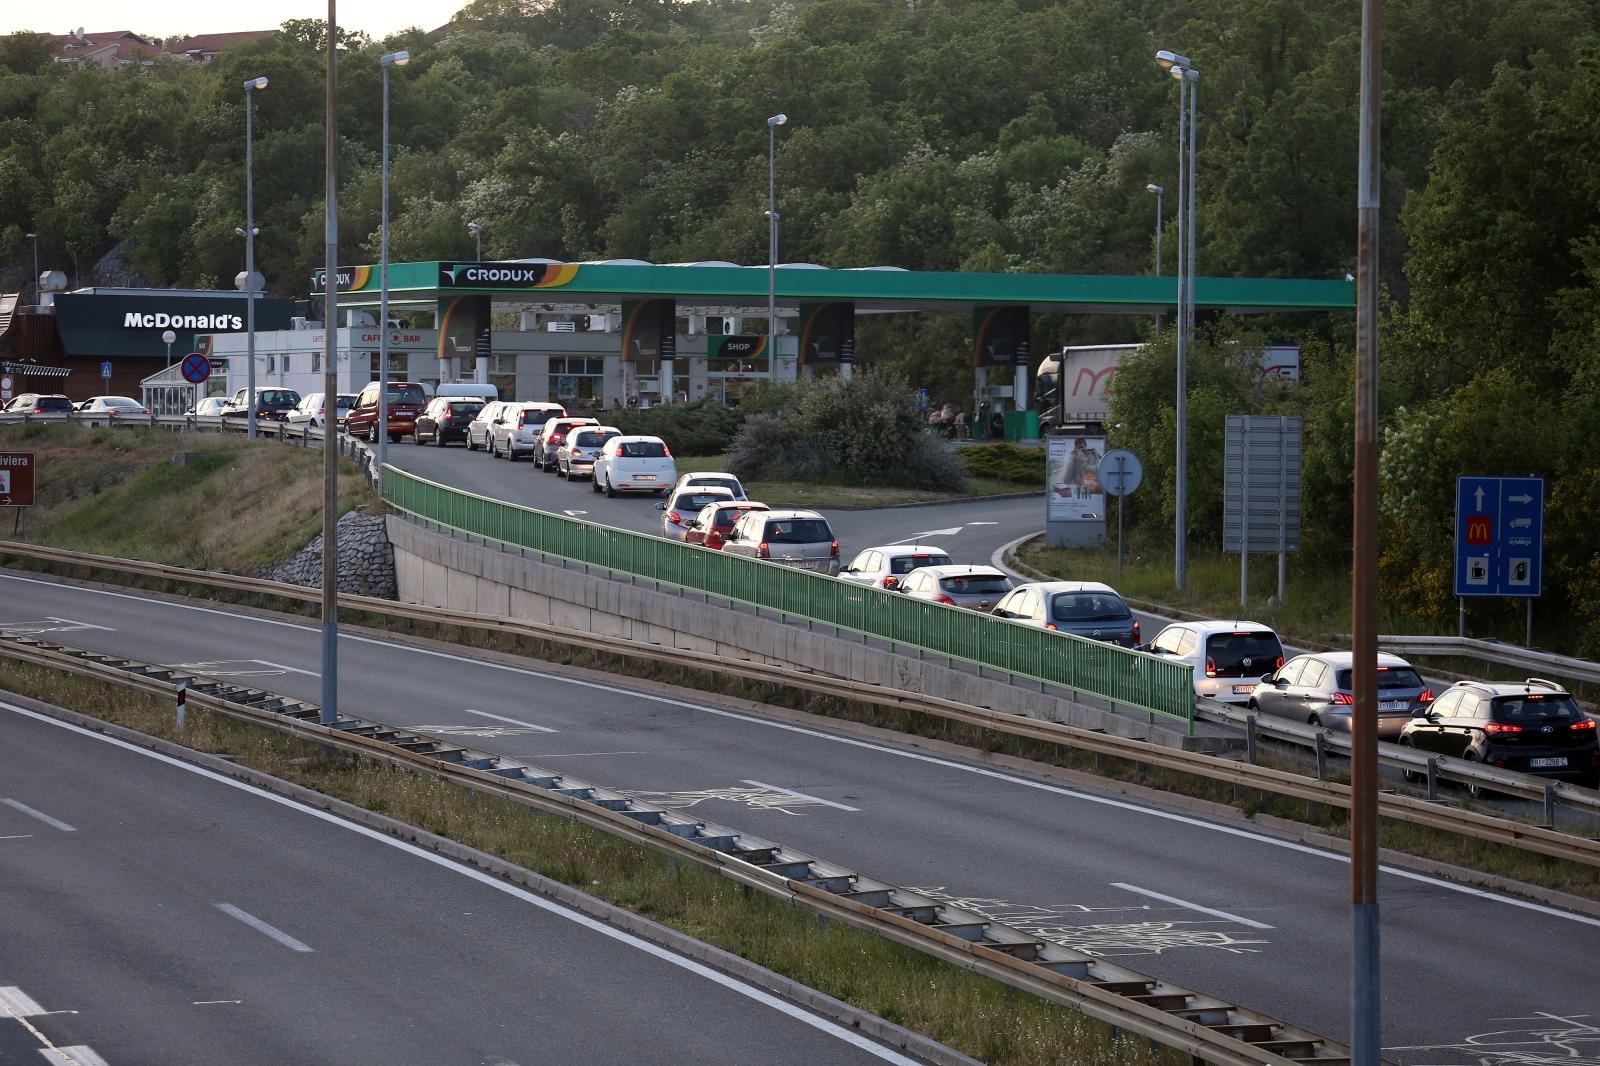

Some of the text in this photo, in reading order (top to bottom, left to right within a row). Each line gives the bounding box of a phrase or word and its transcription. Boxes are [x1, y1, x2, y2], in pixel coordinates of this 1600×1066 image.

[320, 274, 350, 285] CDUX
[466, 269, 534, 281] CRODUX
[124, 312, 243, 330] McDonald's
[403, 335, 420, 343] BAR
[727, 343, 750, 351] SHOP
